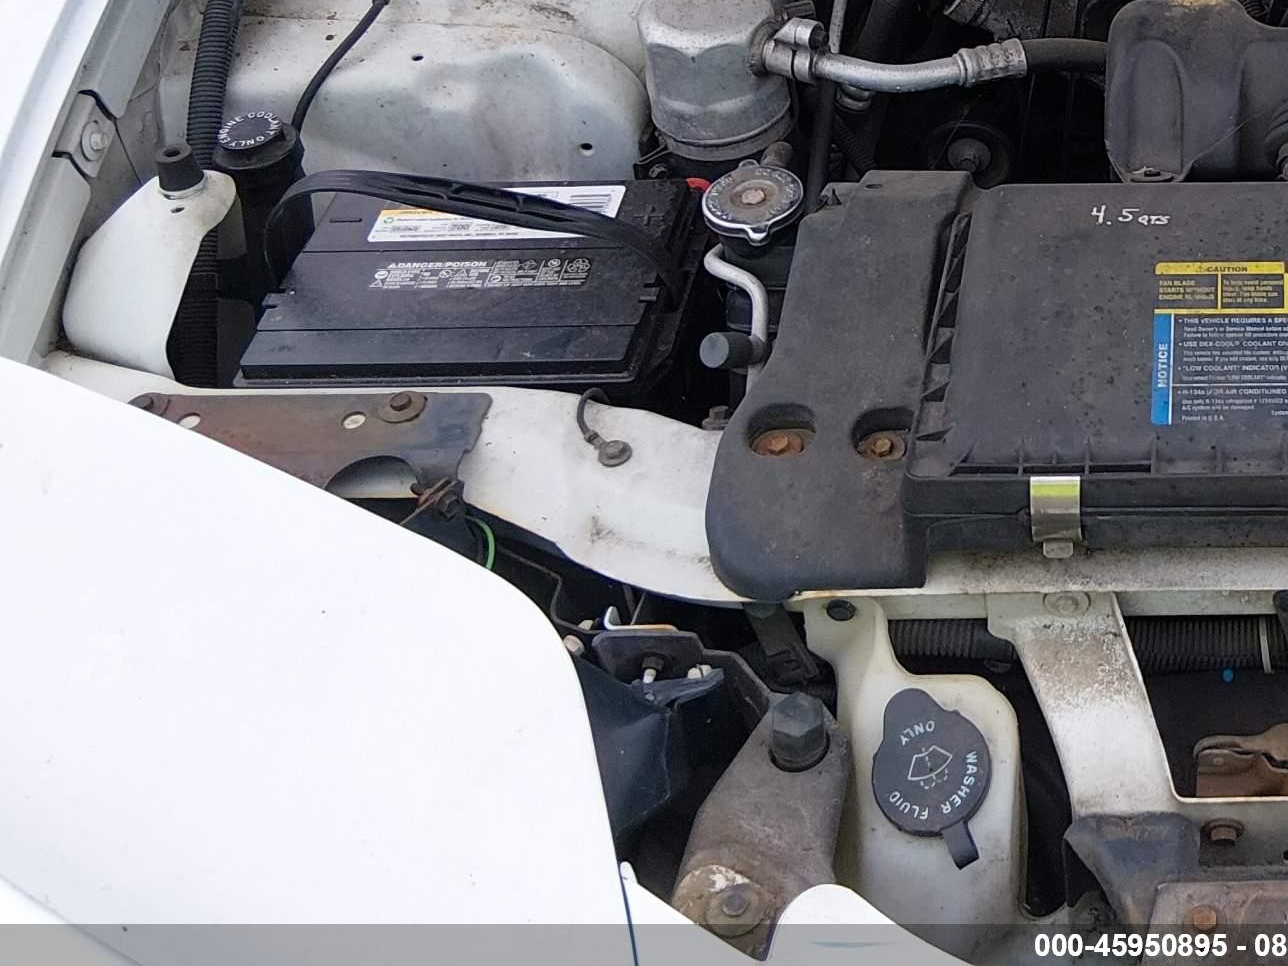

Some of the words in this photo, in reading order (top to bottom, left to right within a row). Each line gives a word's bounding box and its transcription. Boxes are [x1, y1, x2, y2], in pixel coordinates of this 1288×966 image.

[218, 116, 244, 143] ENGINE
[247, 112, 280, 136] COOLANT
[228, 136, 264, 147] ONLY
[1157, 342, 1168, 388] NOTICE
[900, 720, 935, 746] ONLY
[941, 751, 978, 814] WASHER
[889, 791, 929, 820] FLUID
